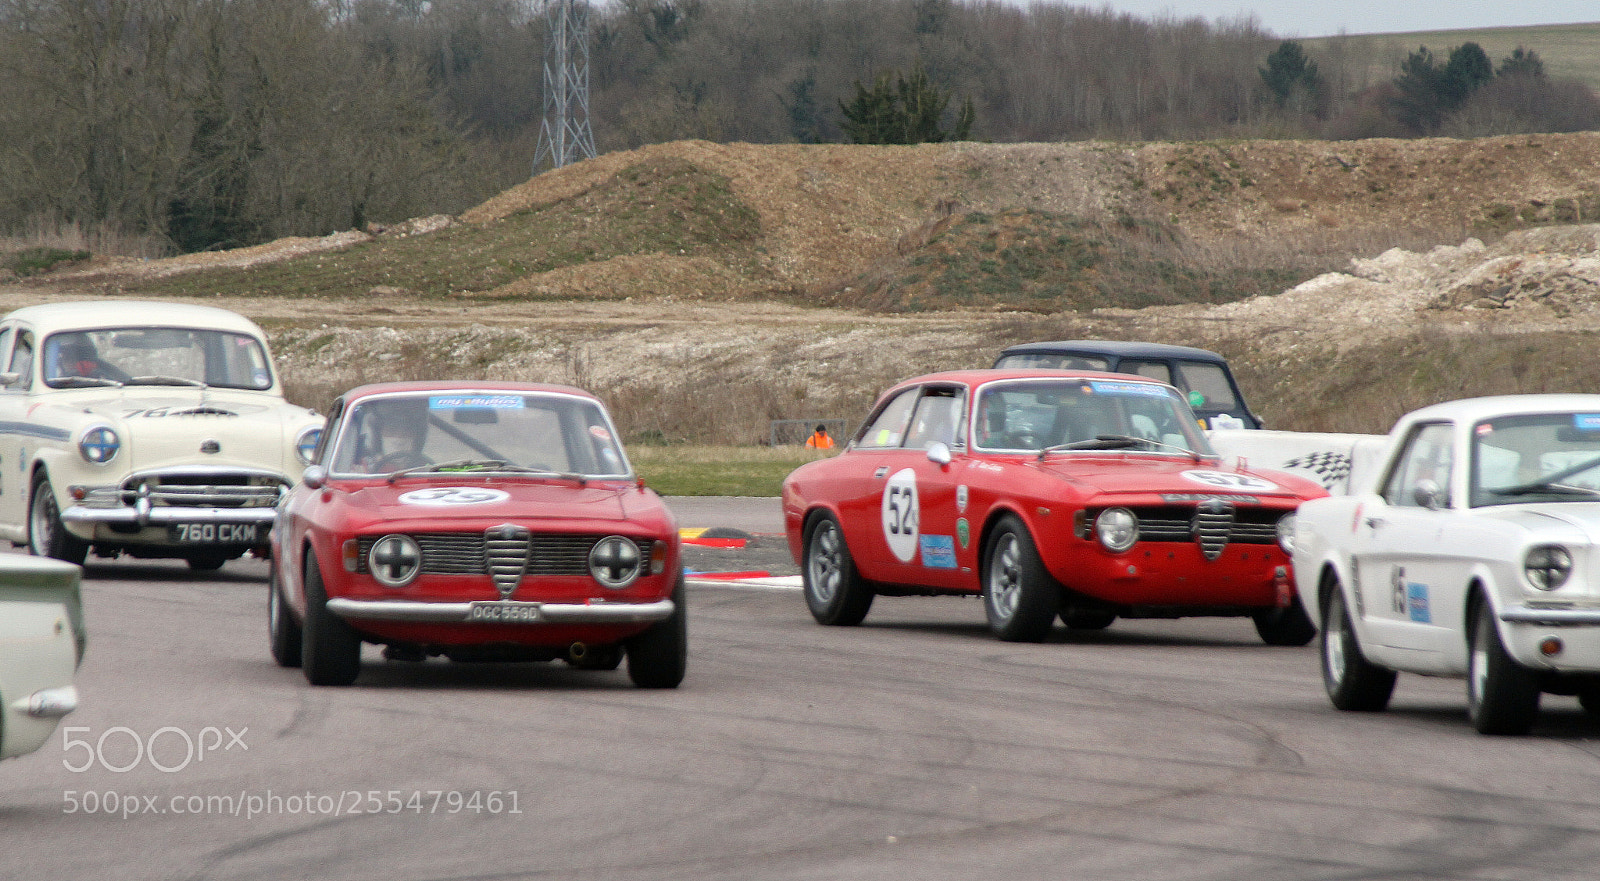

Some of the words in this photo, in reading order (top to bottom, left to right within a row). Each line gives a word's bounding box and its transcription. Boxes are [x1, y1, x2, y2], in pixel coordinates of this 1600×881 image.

[1189, 472, 1268, 488] 52
[889, 486, 913, 535] 52
[176, 523, 215, 542] 760
[218, 523, 257, 542] CKM
